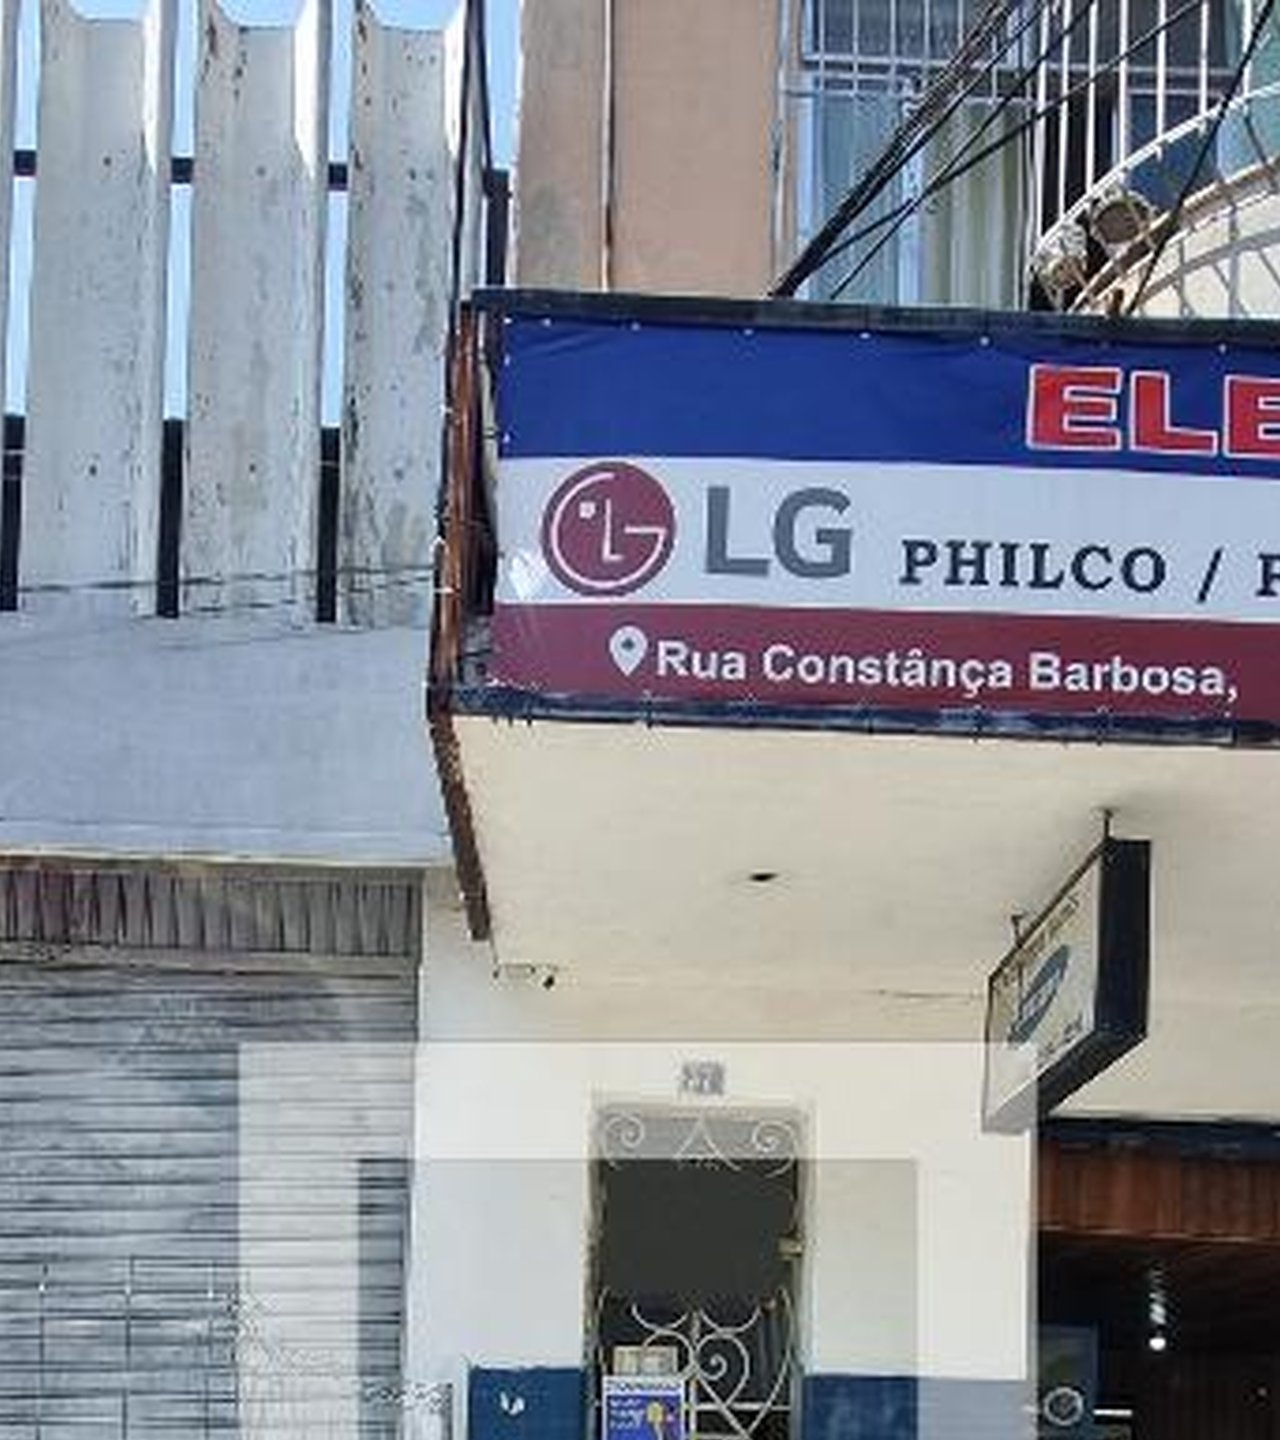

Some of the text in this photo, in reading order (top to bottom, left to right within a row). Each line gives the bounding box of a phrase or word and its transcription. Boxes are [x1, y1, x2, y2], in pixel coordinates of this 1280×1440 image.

[705, 485, 854, 579] LG
[900, 537, 1167, 593] PHILCO
[657, 640, 747, 681] Rua
[763, 644, 1012, 698] Constânça
[1029, 652, 1239, 700] Barbosa,
